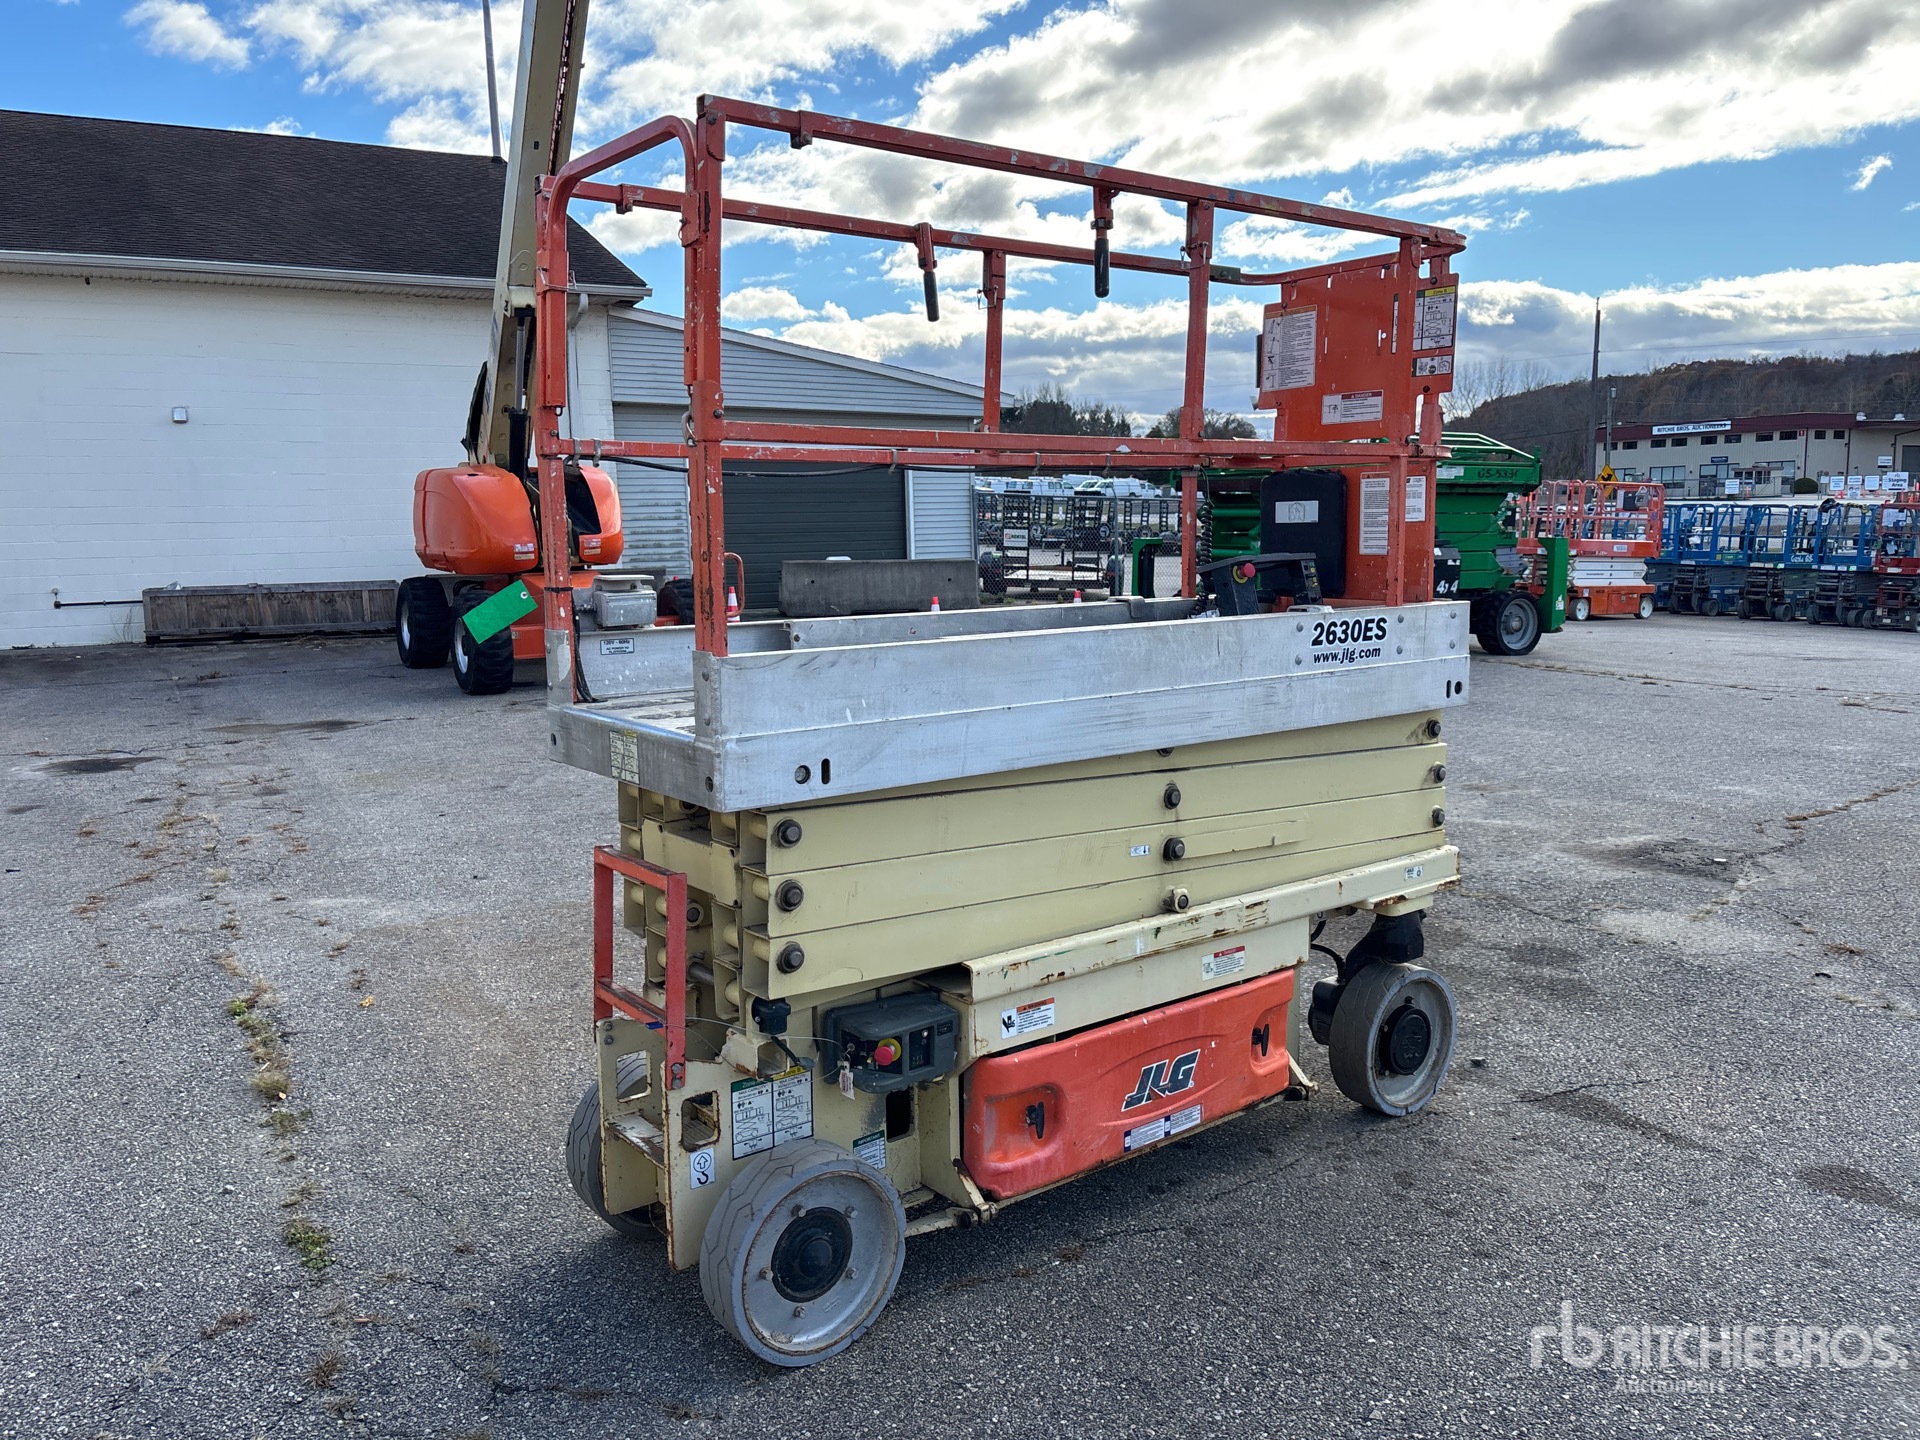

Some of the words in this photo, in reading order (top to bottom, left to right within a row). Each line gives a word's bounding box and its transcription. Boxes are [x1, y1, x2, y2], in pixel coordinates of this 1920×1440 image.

[1692, 423, 1727, 431] AUCTIONEERS
[1311, 617, 1388, 646] 2630ES
[1313, 647, 1381, 664] www.jlg.com
[1121, 1048, 1201, 1112] JLG
[857, 1134, 881, 1145] IMPORTANT
